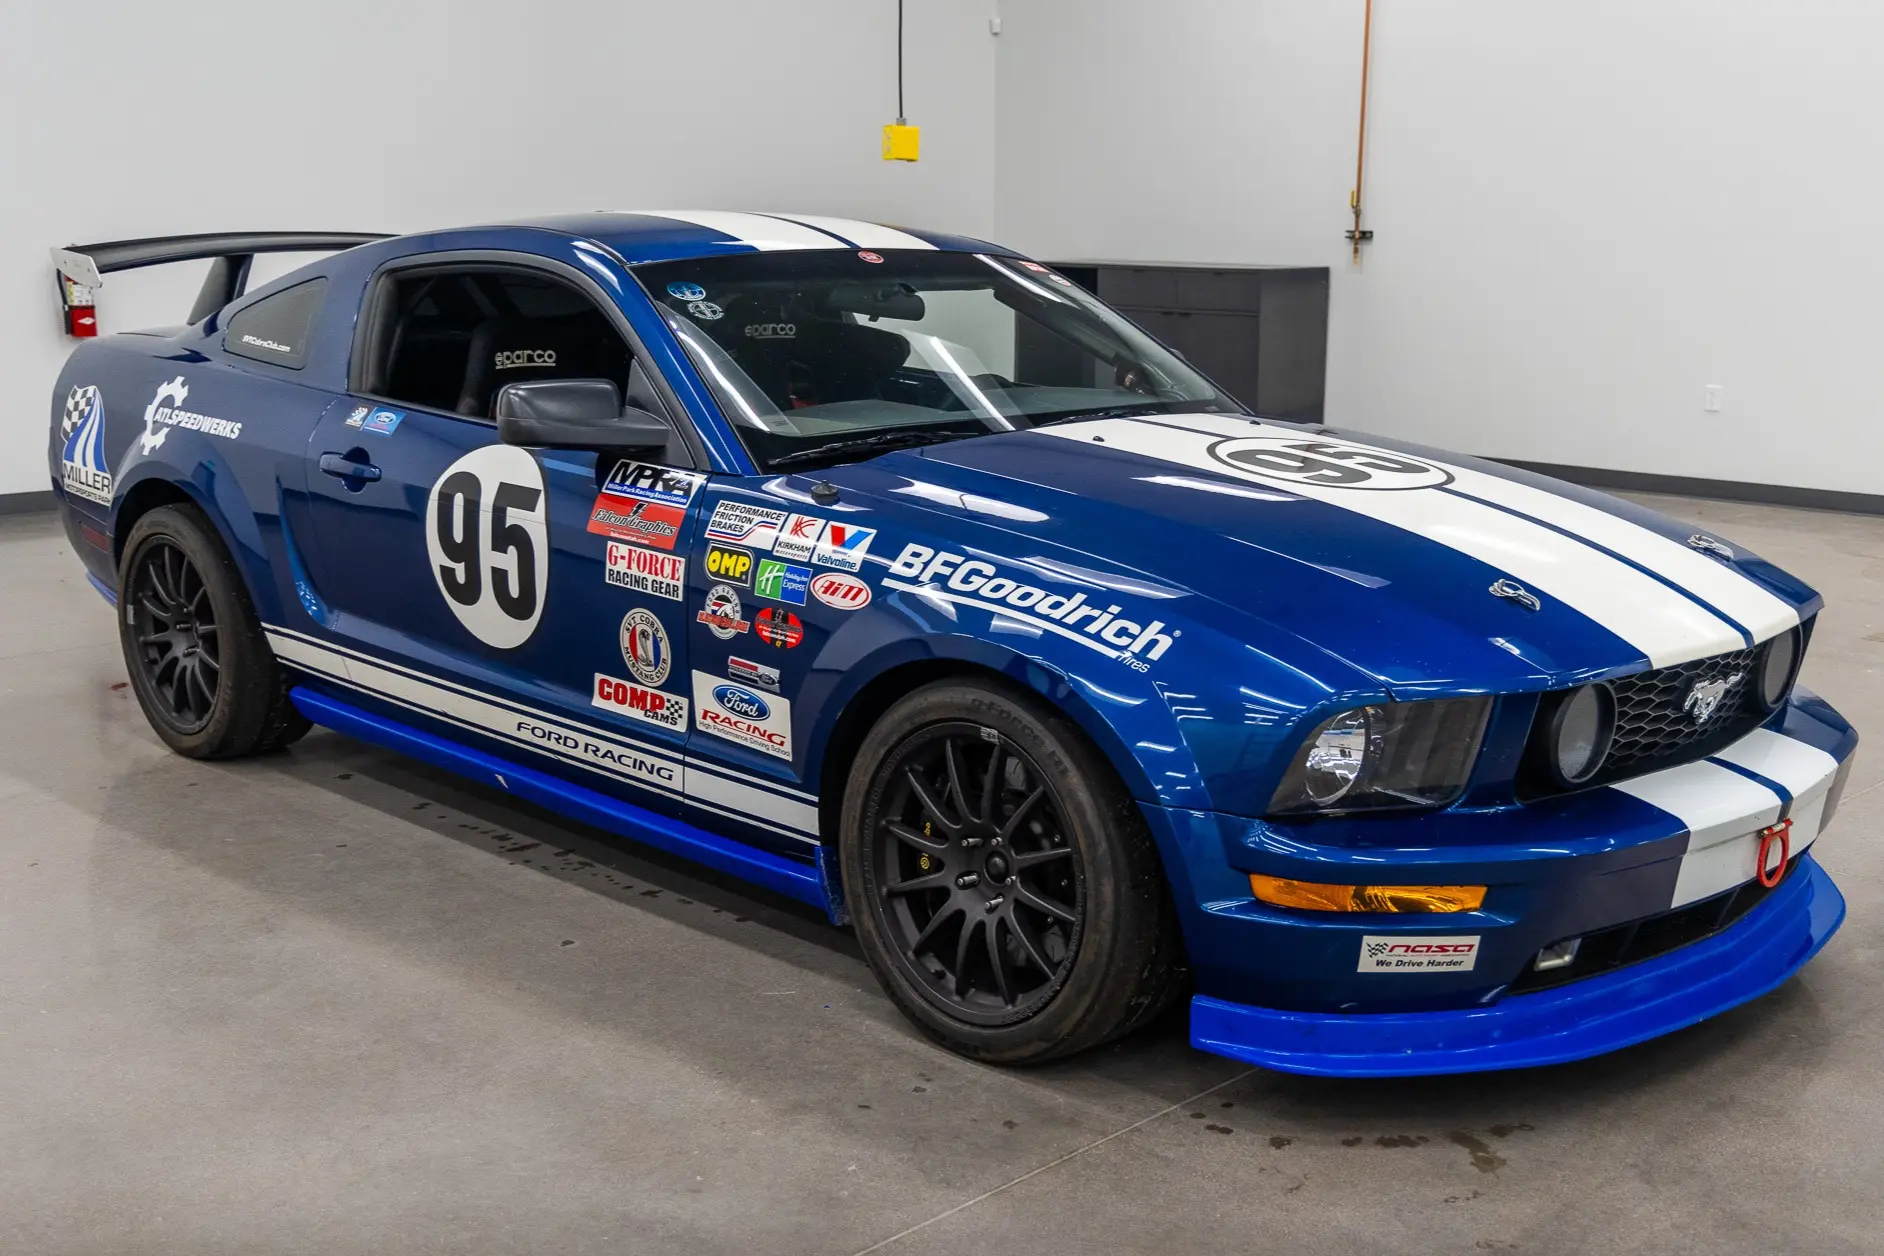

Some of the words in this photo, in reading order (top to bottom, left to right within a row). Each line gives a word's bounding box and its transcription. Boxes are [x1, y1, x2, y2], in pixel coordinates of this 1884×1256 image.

[745, 323, 796, 338] sparco
[495, 350, 556, 369] sparco
[1226, 443, 1431, 484] 95
[63, 463, 111, 494] MILLER
[592, 508, 628, 526] Falcon
[627, 516, 677, 536] Graphics
[714, 511, 754, 525] FRICTION
[718, 502, 783, 521] PERFORMANCE
[710, 520, 745, 533] BRAKES
[437, 471, 542, 621] 95
[777, 540, 812, 554] KIRKHAM
[607, 544, 682, 582] G-FORCE
[708, 551, 750, 577] OMP
[817, 553, 857, 571] Valvoline
[608, 568, 648, 591] RACING
[651, 579, 680, 599] GEAR
[782, 579, 805, 592] Express
[888, 542, 1174, 661] BFGoodrich
[625, 616, 637, 634] SVT
[640, 614, 664, 643] COBRA
[624, 646, 655, 681] MUSTANG
[655, 657, 667, 679] CLUB
[598, 678, 666, 713] COMP
[724, 689, 758, 716] Ford
[643, 709, 678, 726] CAMS
[701, 709, 787, 748] RACING
[700, 720, 712, 730] High
[750, 737, 770, 751] Driving
[516, 721, 579, 749] FORD
[583, 743, 674, 782] RACING
[1388, 944, 1475, 953] nasa
[1375, 959, 1392, 967] We
[1395, 959, 1424, 967] Drive
[1426, 959, 1464, 967] Harder
